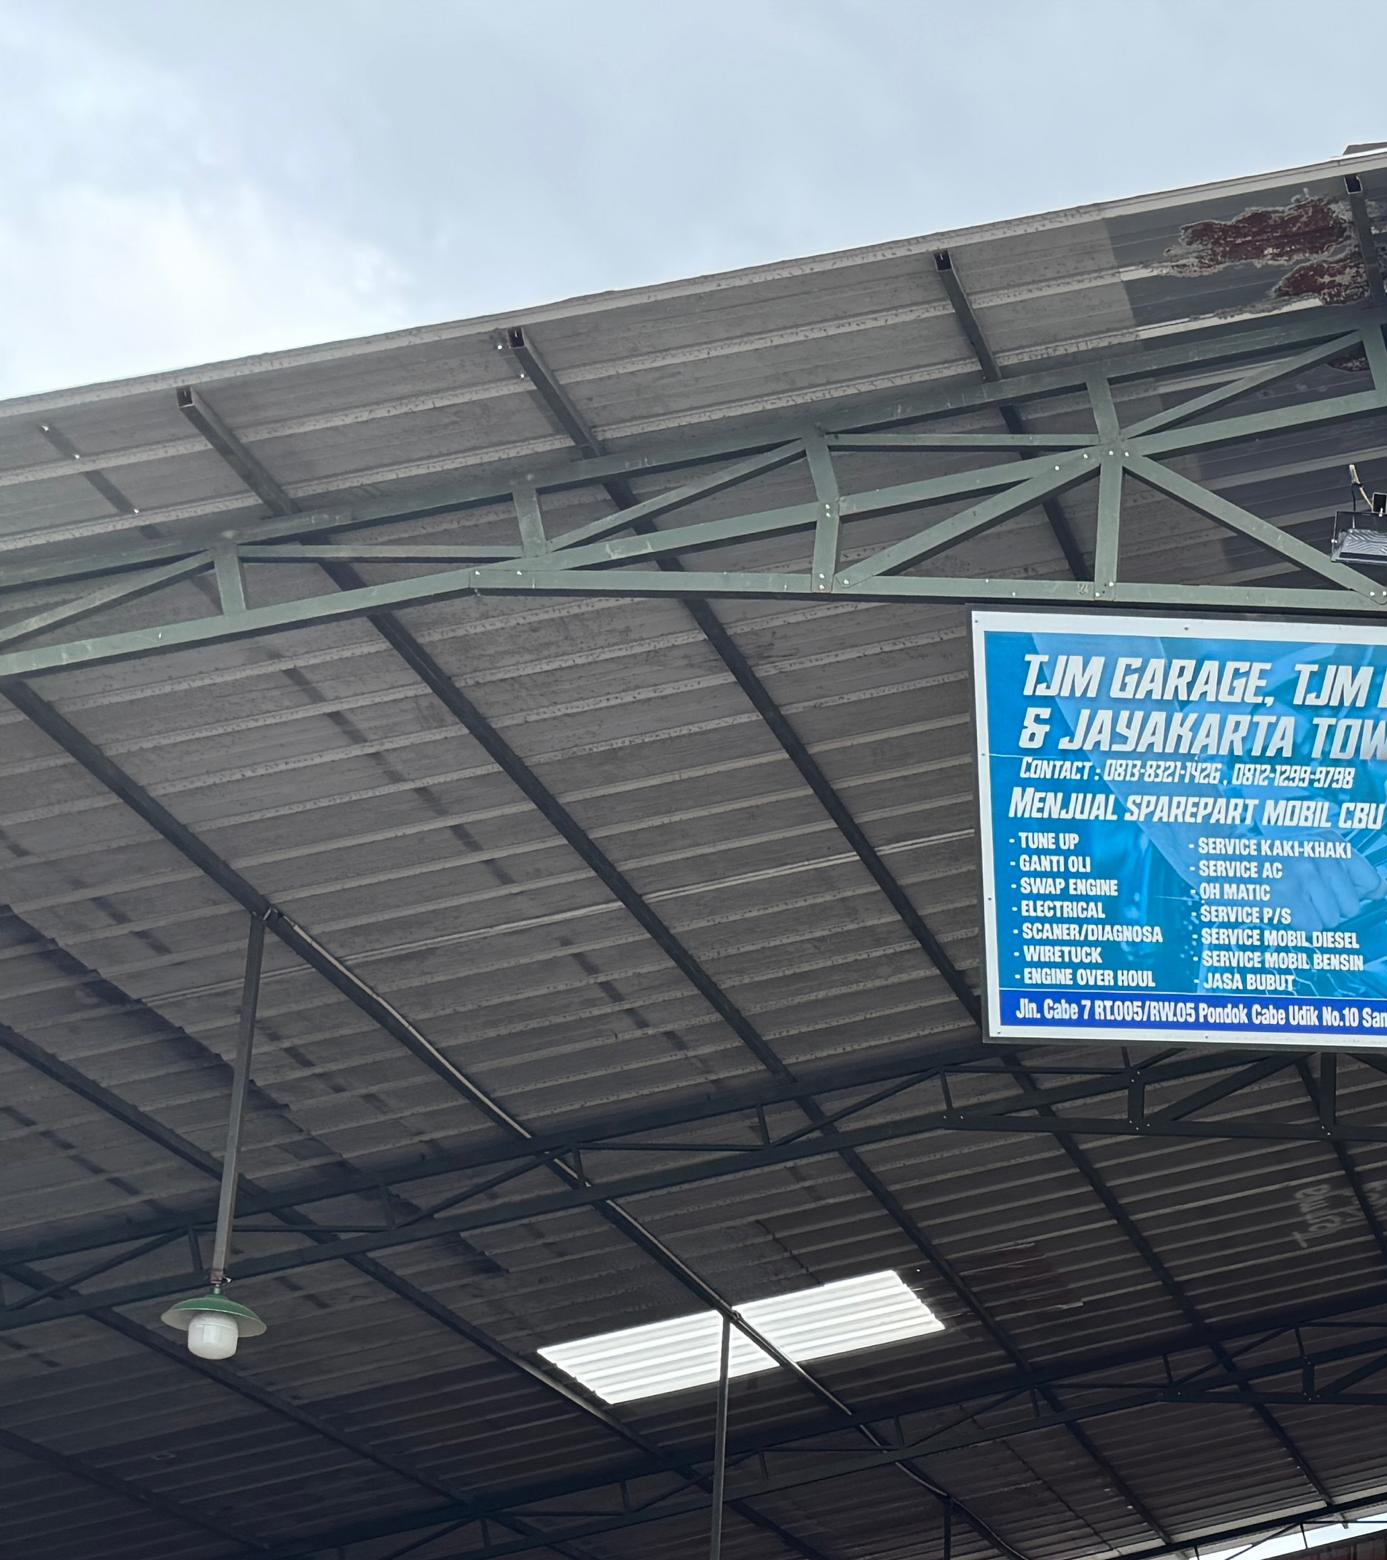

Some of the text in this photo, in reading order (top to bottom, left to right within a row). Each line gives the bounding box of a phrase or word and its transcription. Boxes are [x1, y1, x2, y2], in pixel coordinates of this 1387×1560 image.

[1023, 654, 1105, 698] TJM
[1109, 657, 1274, 707] GARAGE,
[1293, 664, 1374, 707] TJM
[1019, 707, 1051, 748] &
[1058, 709, 1295, 757] JAYAKARTA
[1103, 759, 1223, 784] 0813-8321-1426
[1124, 795, 1259, 825] SPAREPART
[1262, 800, 1332, 828] MOBIL
[1338, 802, 1386, 830] CBU
[1018, 832, 1080, 850] TUNE UP
[1198, 837, 1352, 858] SERVICE KAKI-KHAKI
[1019, 855, 1091, 872] GANTI OLI
[1199, 860, 1283, 879] SERVICE AC
[1020, 877, 1118, 896] SWAP ENGINE
[1200, 883, 1271, 901] OH MATIC
[1021, 900, 1105, 918] ELECTRICAL
[1200, 905, 1292, 924] SERVICE P/S
[1022, 923, 1163, 943] SCANER/DIAGNOSA
[1201, 928, 1360, 948] SERVICE MOBIL DIESEL
[1023, 945, 1103, 963] WIRETUCK
[1202, 951, 1364, 971] SERVICE MOBIL BENSIN
[1024, 968, 1156, 987] ENGINE OVER HOUL
[1203, 972, 1295, 991] JASA BUBUT
[1043, 999, 1079, 1019] Cabe
[1081, 1000, 1091, 1020] 7
[1094, 1000, 1196, 1022] RT.005/RW.05
[1198, 1003, 1248, 1024] Pondok
[1251, 1004, 1285, 1025] Cabe
[1289, 1005, 1319, 1026] Udik
[1322, 1006, 1359, 1027] No.10
